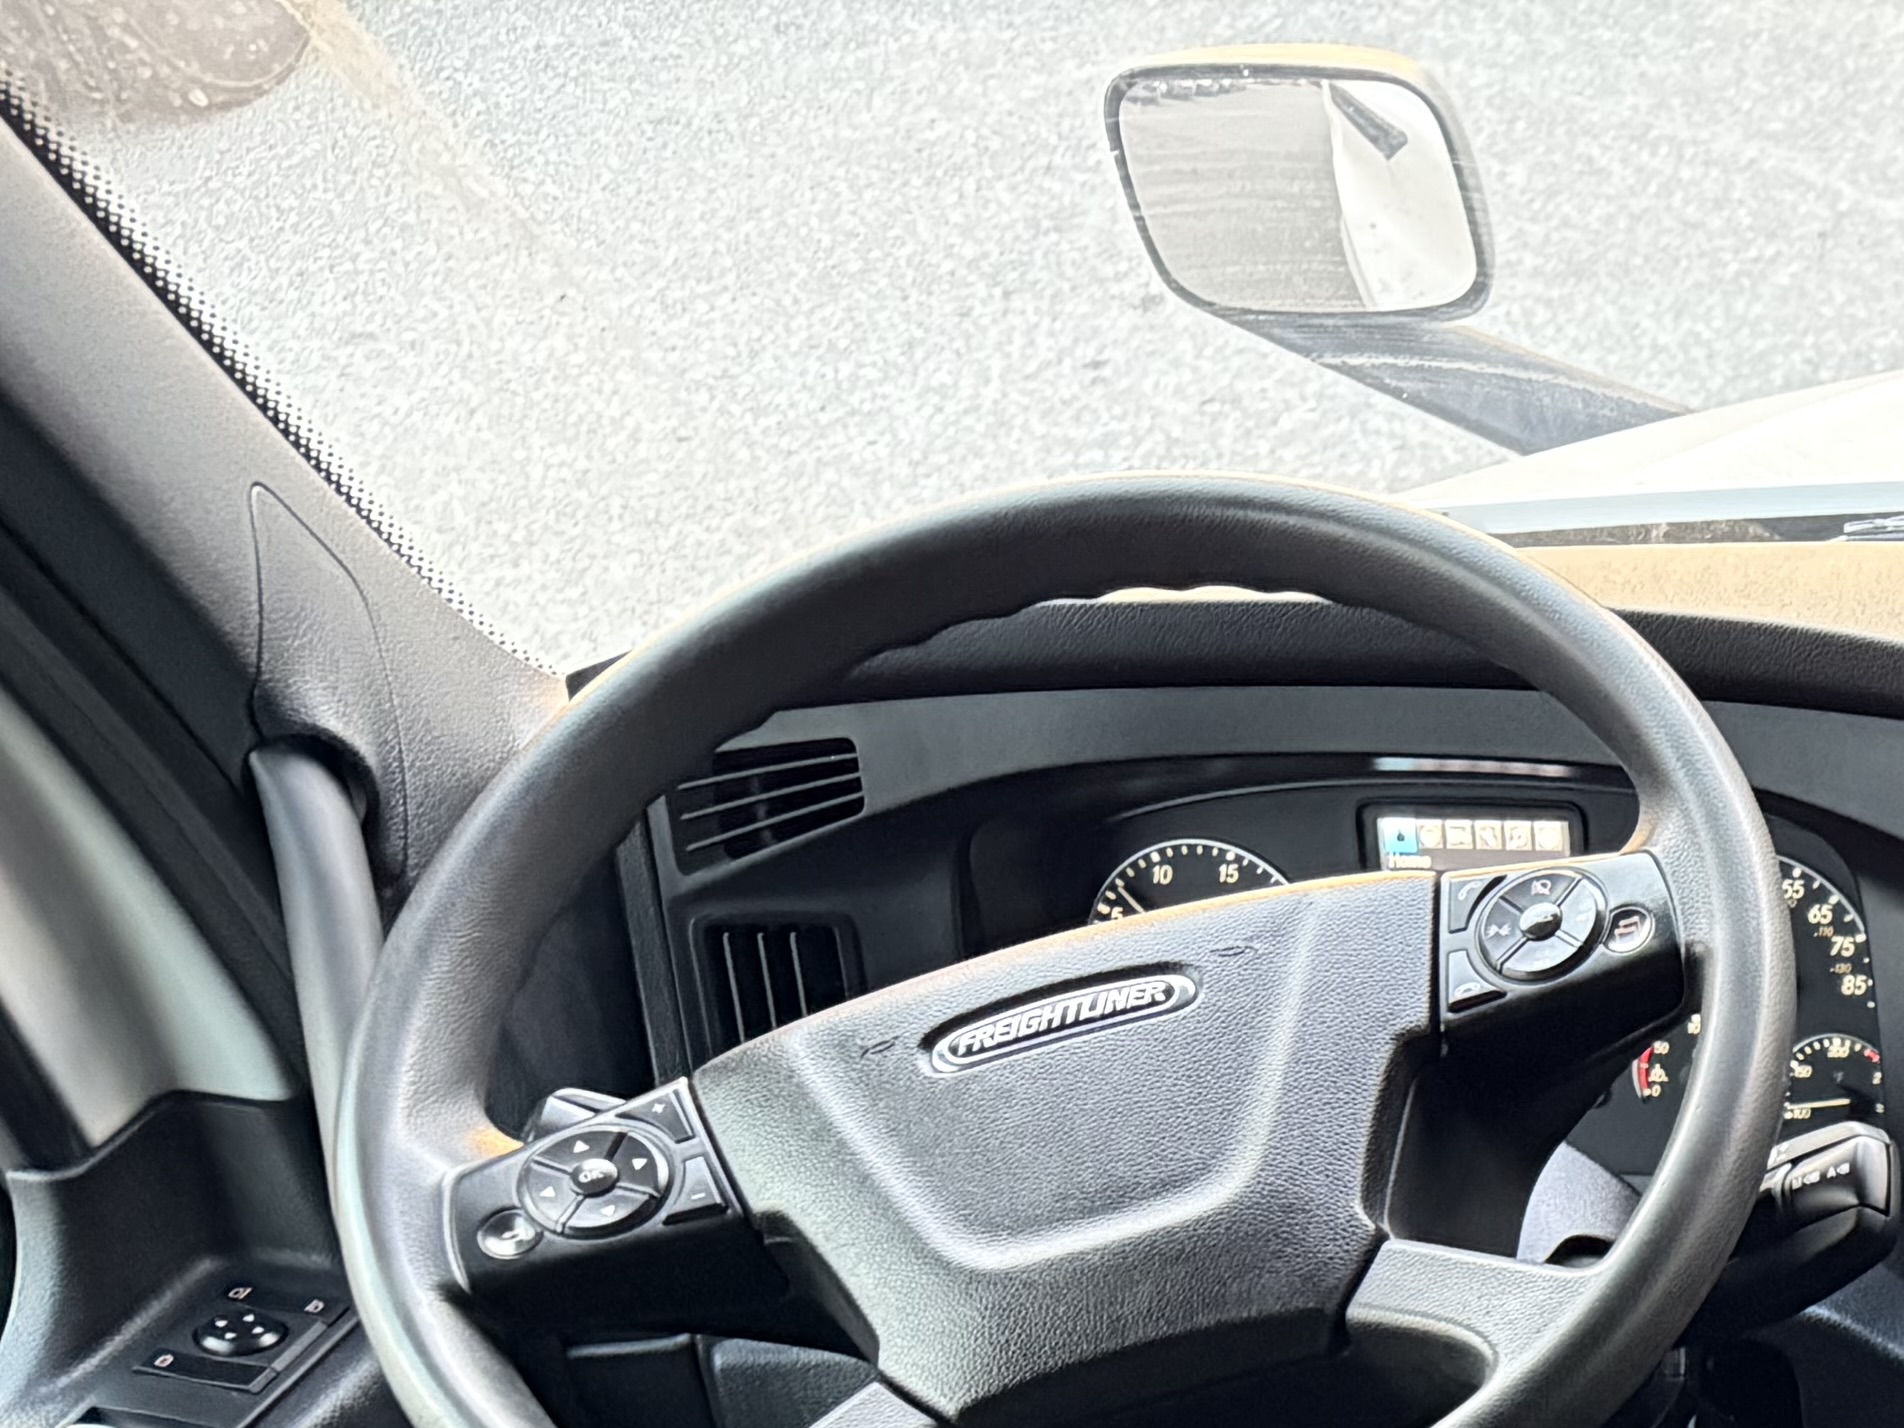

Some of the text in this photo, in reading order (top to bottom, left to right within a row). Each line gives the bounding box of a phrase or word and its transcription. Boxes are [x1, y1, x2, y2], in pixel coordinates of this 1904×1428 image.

[1152, 865, 1173, 885] 10
[1219, 864, 1239, 883] 15
[1782, 879, 1805, 899] 55
[1807, 904, 1833, 925] 65
[1830, 936, 1855, 958] 75
[1841, 974, 1867, 996] 85
[957, 982, 1167, 1056] FREIGHTLINER
